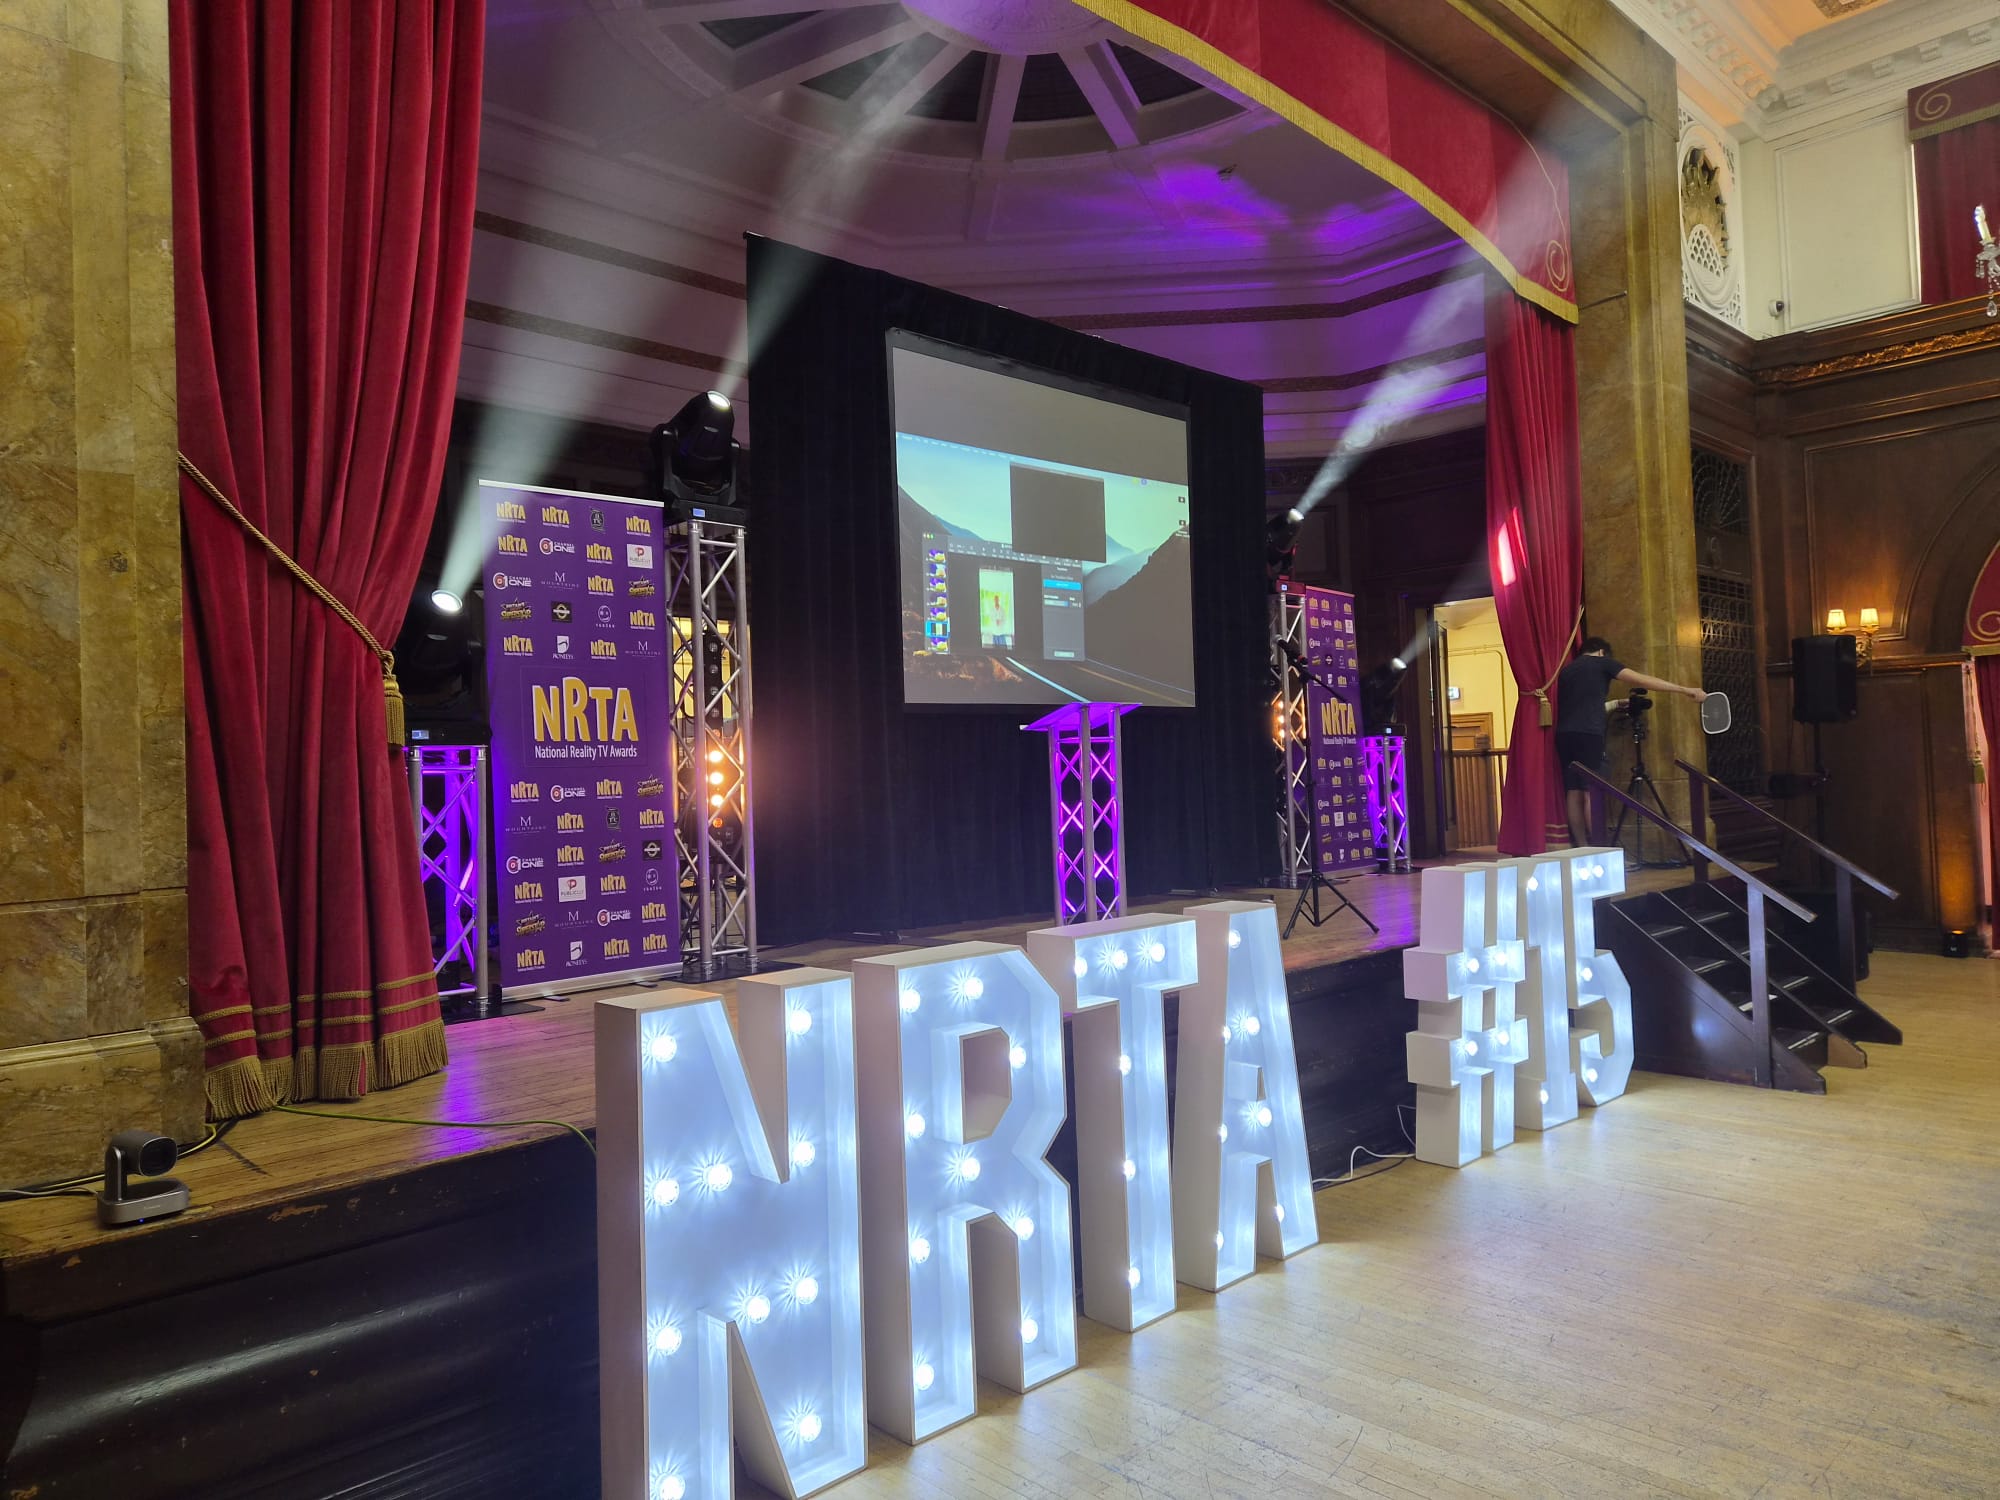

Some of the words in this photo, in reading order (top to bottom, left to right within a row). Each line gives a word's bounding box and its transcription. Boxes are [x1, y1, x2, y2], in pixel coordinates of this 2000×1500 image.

[496, 501, 526, 519] NRTA
[541, 506, 569, 525] NRTA
[626, 516, 651, 534] NRTA
[498, 534, 528, 552] NRTA
[554, 545, 575, 554] ONE
[586, 543, 613, 561] NRTA
[588, 575, 614, 593] NRTA
[630, 609, 656, 627] NRTA
[504, 634, 534, 654] NRTA
[590, 639, 617, 657] NRTA
[532, 676, 639, 742] NRTA
[1321, 697, 1357, 736] NRTA
[535, 745, 568, 759] National
[570, 745, 597, 761] Reality
[597, 745, 609, 758] TV
[610, 745, 638, 758] Awards
[511, 781, 539, 799] NRTA
[597, 779, 623, 796] NRTA
[557, 812, 584, 830] NRTA
[640, 809, 665, 826] NRTA
[557, 845, 584, 863] NRTA
[521, 861, 544, 869] ONE
[514, 881, 543, 900] NRTA
[600, 874, 626, 892] NRTA
[610, 913, 631, 921] ONE
[642, 902, 667, 919] NRTA
[604, 938, 630, 956] NRTA
[643, 933, 668, 951] NRTA
[516, 949, 546, 968] NRTA
[597, 900, 1320, 1500] NRTA
[1403, 847, 1635, 1168] #15
